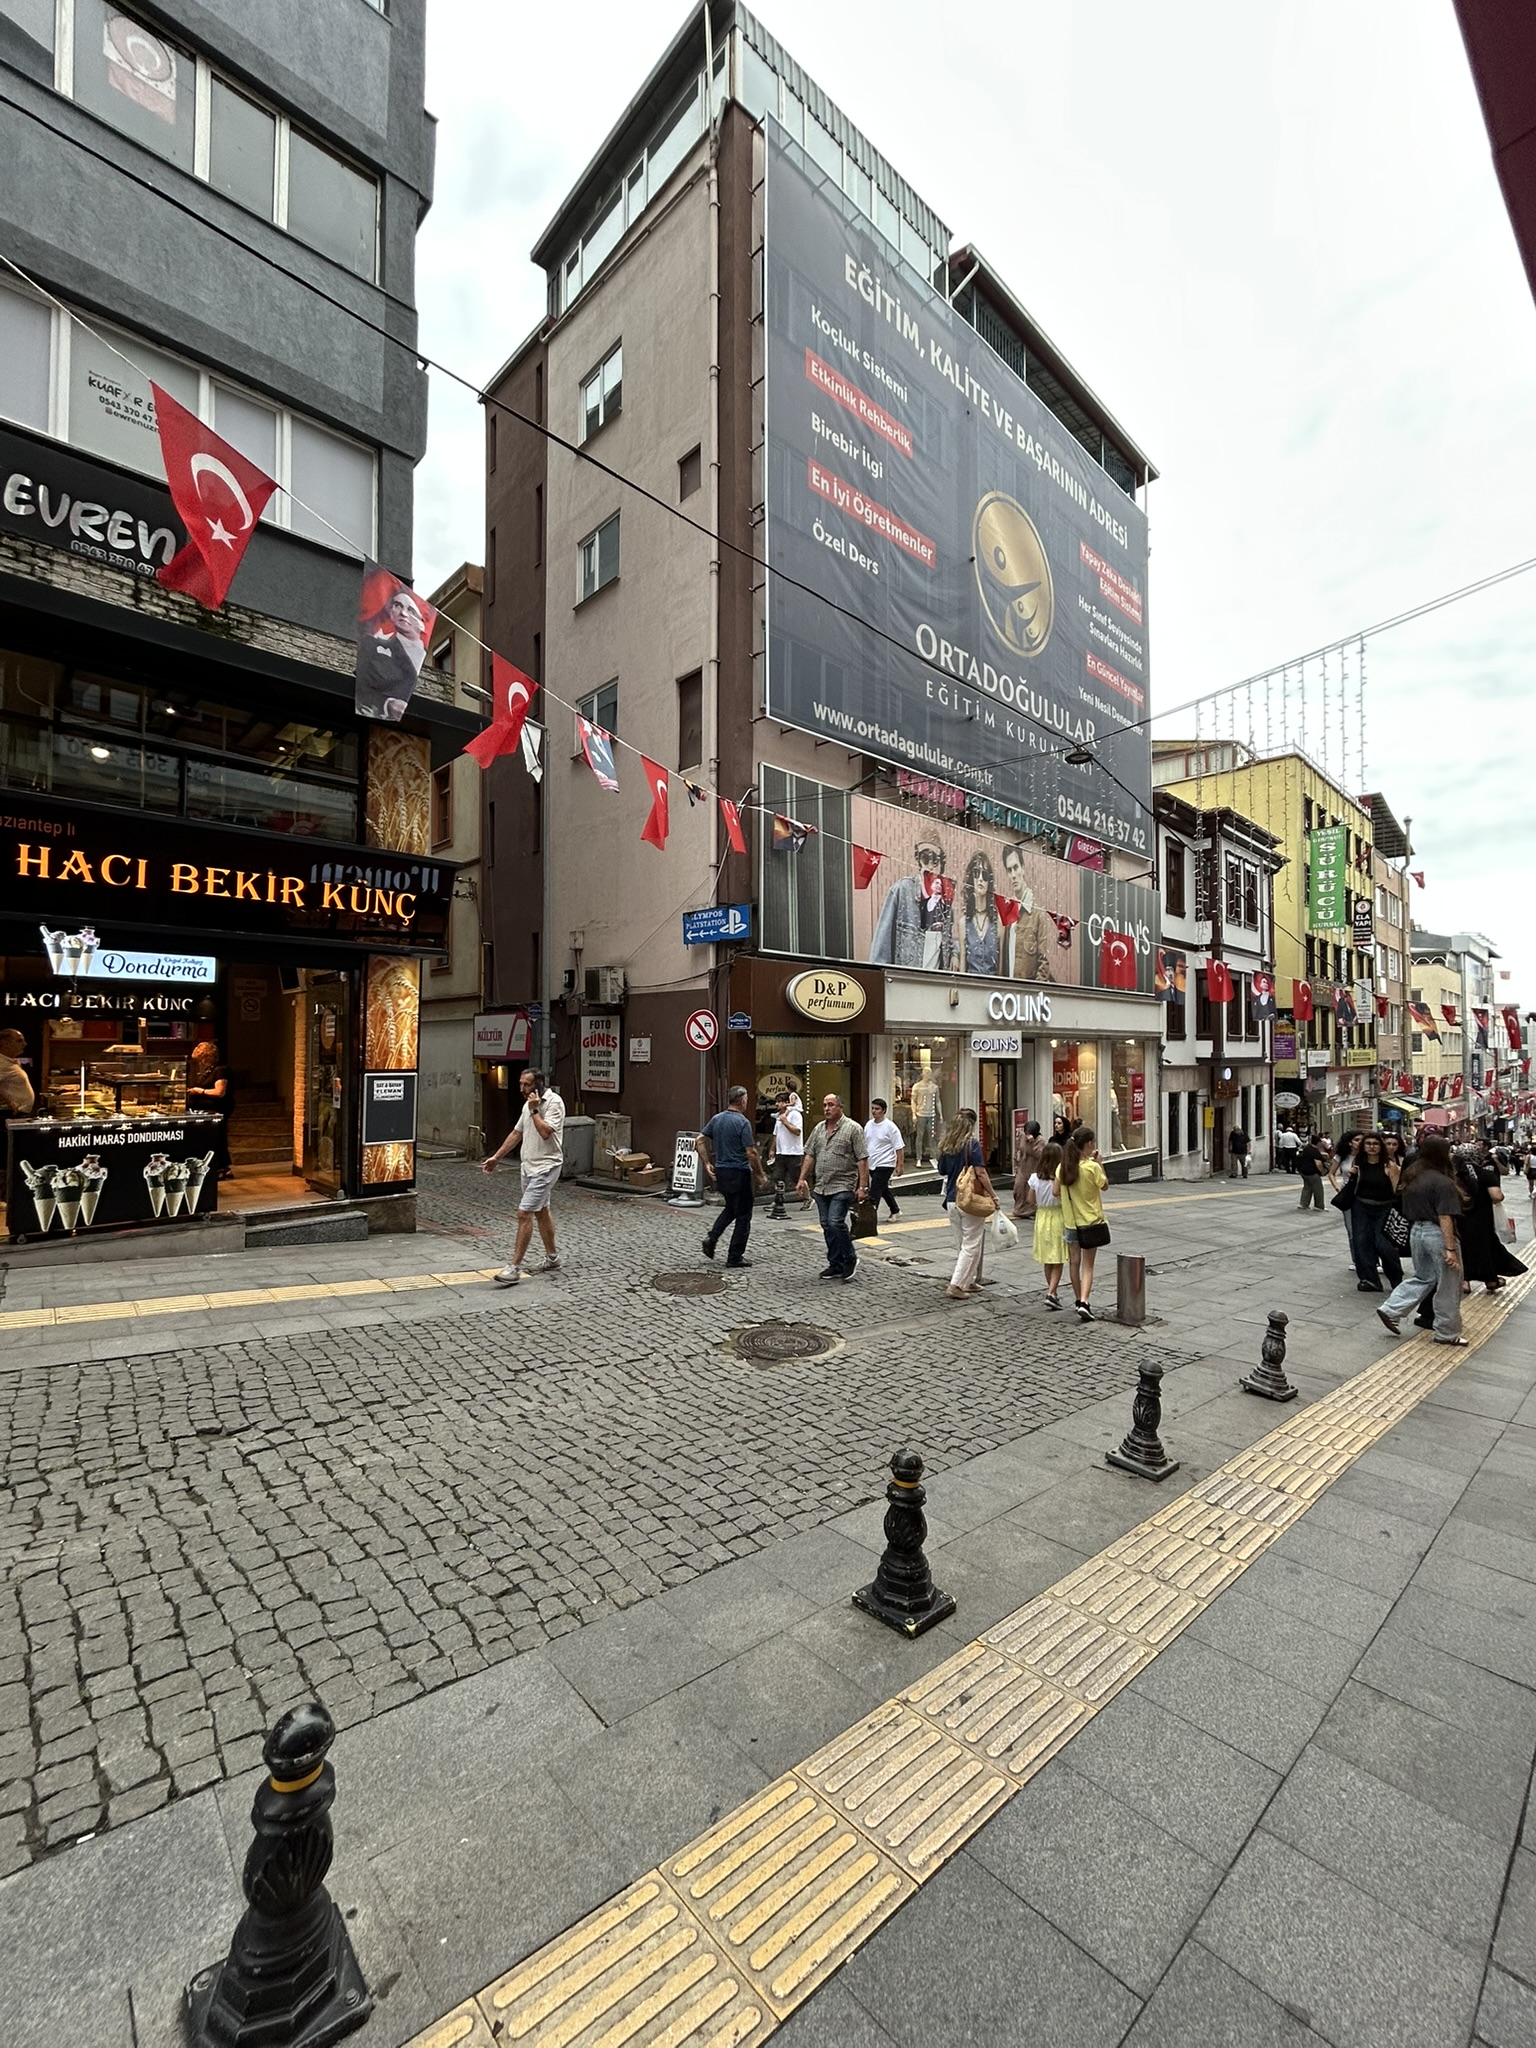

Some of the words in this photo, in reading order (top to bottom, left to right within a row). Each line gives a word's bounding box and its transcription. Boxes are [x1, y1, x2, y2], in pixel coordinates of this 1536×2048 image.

[811, 304, 860, 362] Koçluk
[862, 350, 908, 403] Sistemi
[124, 405, 141, 418] 370
[142, 413, 153, 423] 47
[811, 360, 857, 408] Etkinlik
[860, 398, 911, 451] Rehberlik
[845, 253, 925, 358] EĞİTİM,
[931, 339, 990, 417] KALİTE
[993, 400, 1013, 440] VE
[1016, 423, 1088, 510] BAŞARININ
[1089, 498, 1128, 549] ADRESİ
[811, 411, 860, 460] Birebir
[862, 445, 883, 479] İlgi
[812, 467, 830, 494] En
[833, 477, 850, 507] İyi
[853, 491, 934, 561] Öğretmenler
[812, 517, 846, 556] Özel
[849, 543, 879, 575] Ders
[1078, 594, 1091, 614] Her
[1089, 621, 1119, 653] Sınavlara
[1086, 653, 1097, 671] En
[1096, 661, 1119, 687] Güncel
[926, 679, 995, 728] EĞİTİM
[1078, 685, 1094, 706] Yeni
[1094, 695, 1111, 717] Nesil
[1058, 794, 1091, 828] 0544
[1132, 826, 1146, 850] 42
[15, 843, 149, 889] HACI
[170, 863, 305, 907] BEKİR
[322, 877, 417, 926] KÜNÇ
[1316, 842, 1338, 920] SÜRÜCÜ
[685, 918, 727, 930] PLAYSTATION
[691, 910, 723, 921] LYMPOS
[102, 952, 208, 979] Dondurma
[5, 992, 60, 1008] HACI
[807, 996, 855, 1010] perfumum
[989, 991, 1052, 1022] COLIN'S
[589, 1020, 611, 1030] FOTO
[583, 1031, 618, 1051] GÜNEŞ
[971, 1036, 1018, 1052] COLIN'S
[58, 1133, 91, 1148] HAKİKİ
[93, 1133, 126, 1146] MARAŞ
[127, 1130, 184, 1144] DONDURMASI
[677, 1154, 692, 1169] 250
